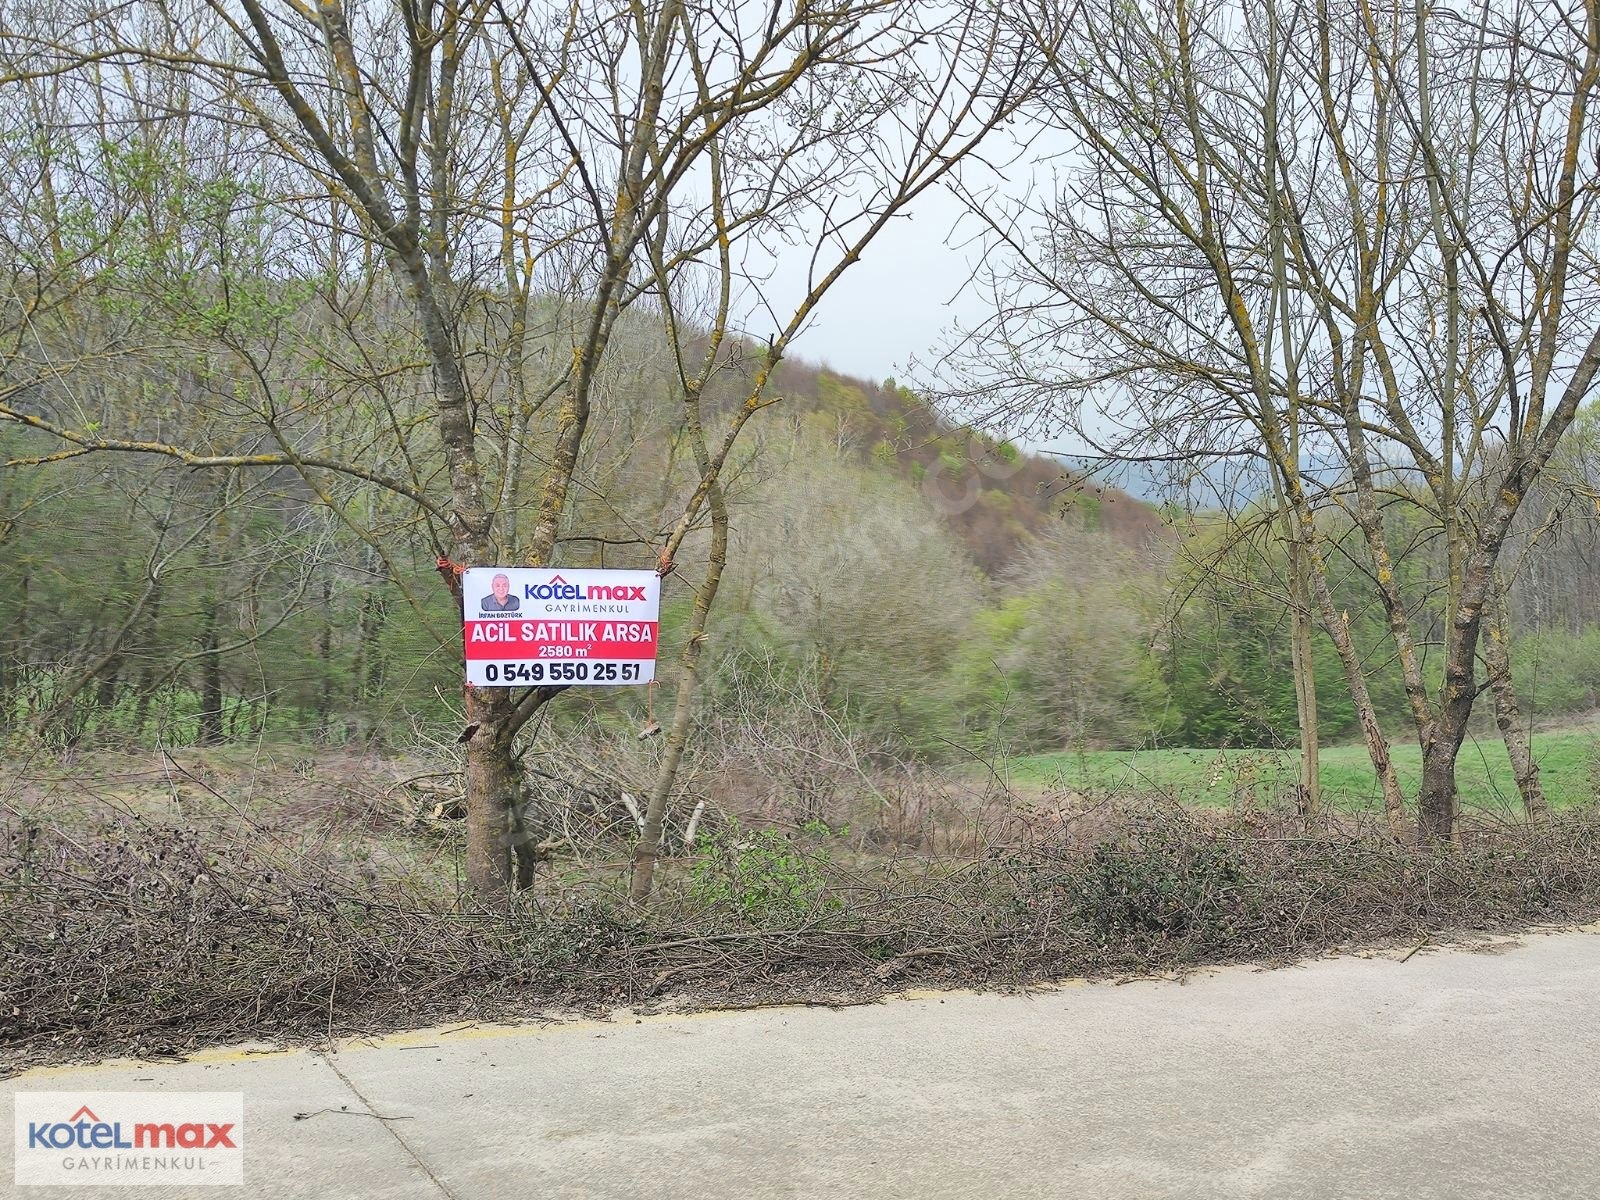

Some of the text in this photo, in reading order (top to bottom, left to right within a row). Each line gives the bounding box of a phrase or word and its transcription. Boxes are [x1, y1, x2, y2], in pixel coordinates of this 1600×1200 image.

[545, 604, 629, 613] GAYRİMENKUL
[521, 623, 597, 642] SATILIK
[601, 623, 653, 643] ARSA
[538, 645, 572, 657] 2580
[485, 663, 640, 682] 0 549 550 25 51
